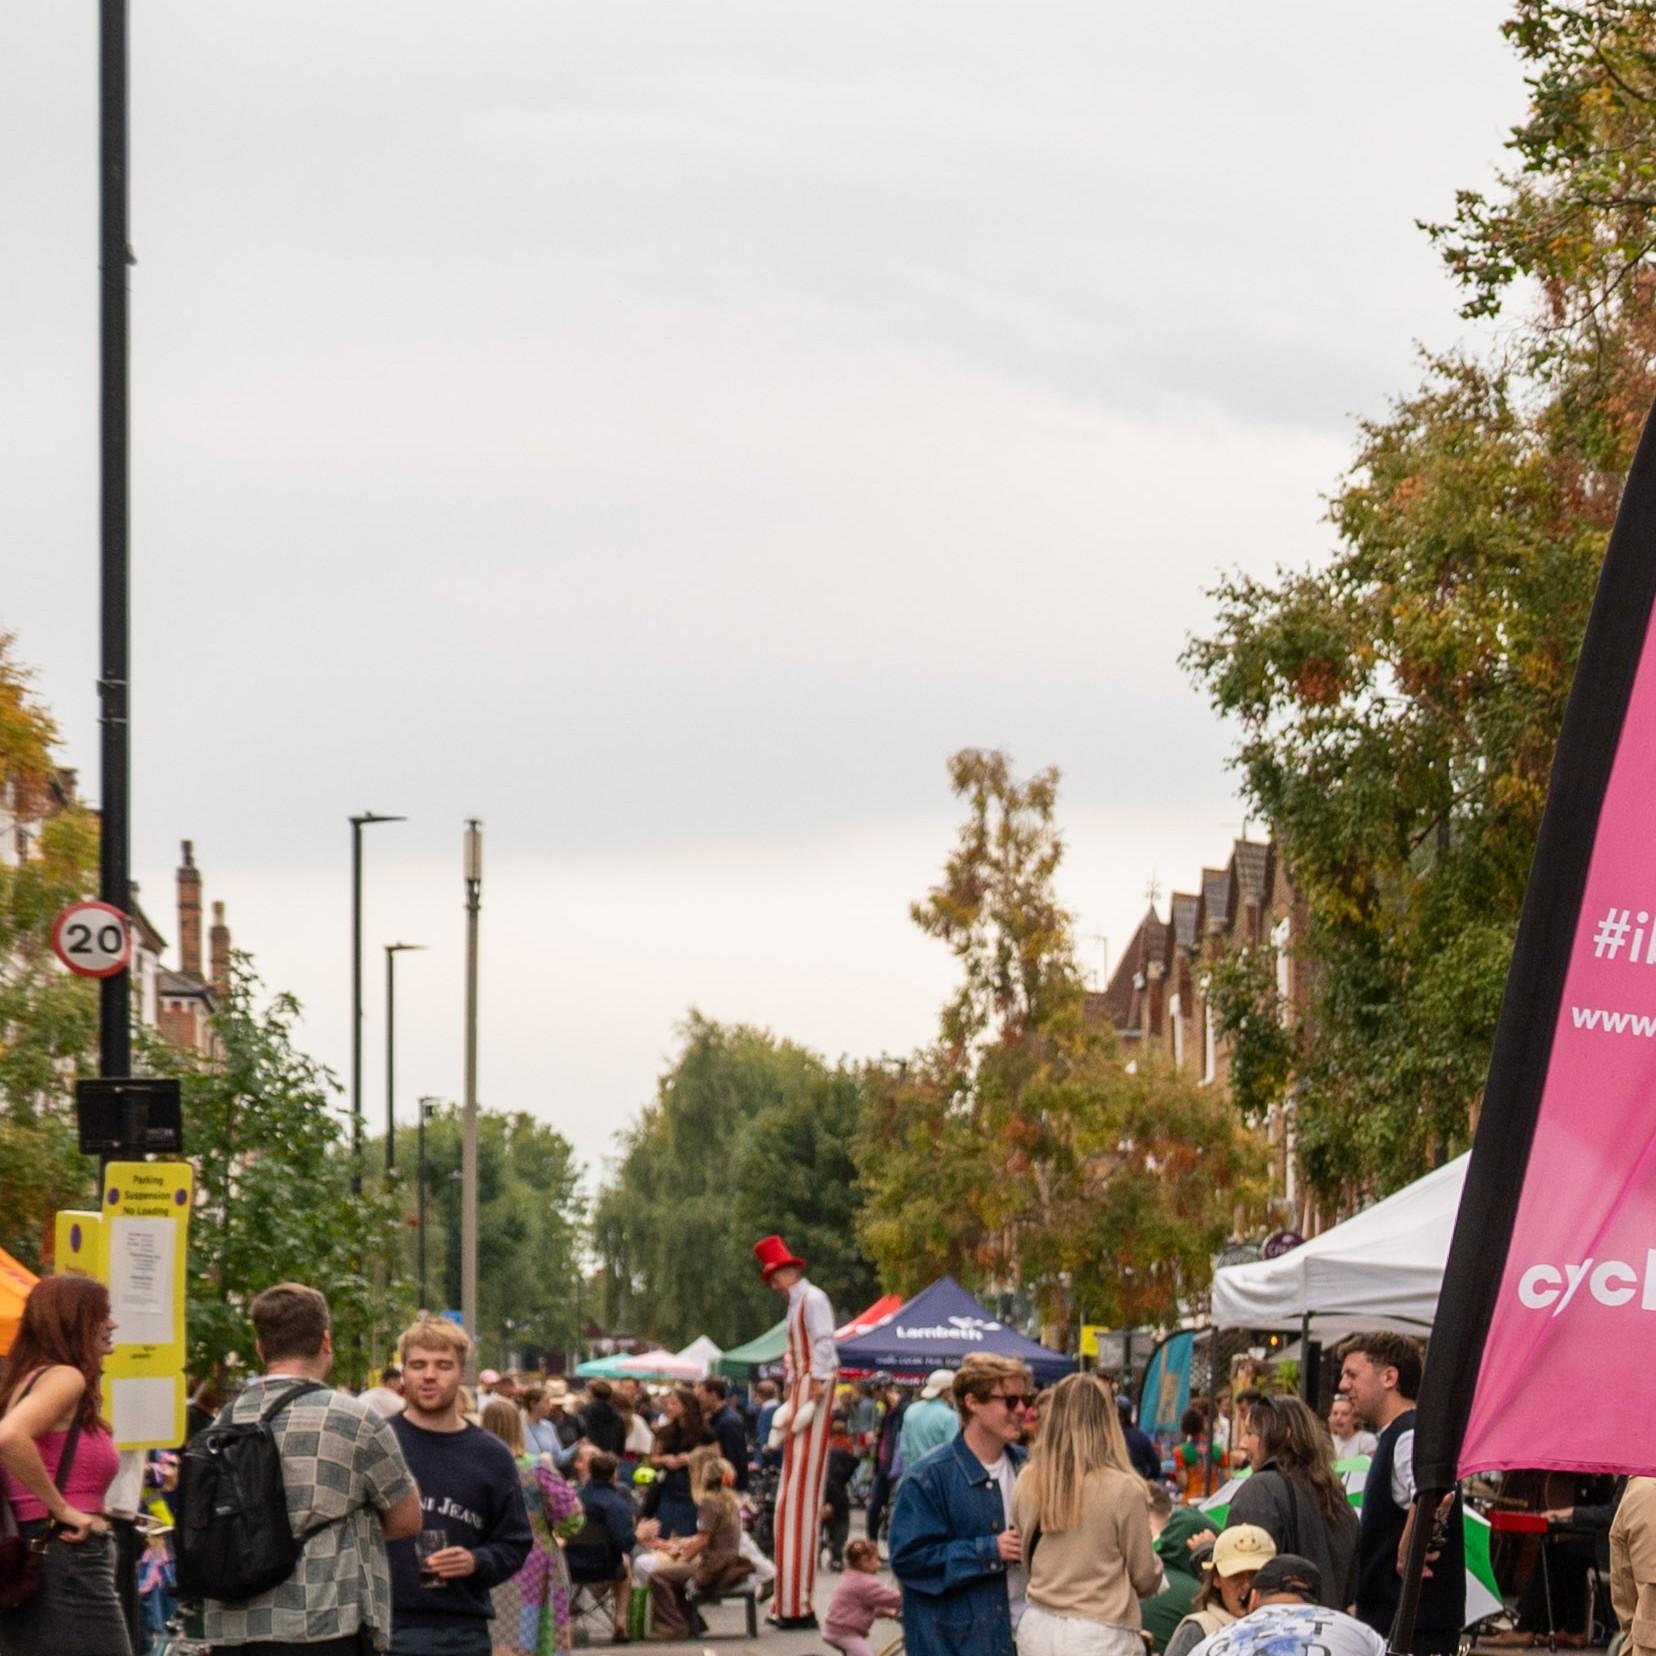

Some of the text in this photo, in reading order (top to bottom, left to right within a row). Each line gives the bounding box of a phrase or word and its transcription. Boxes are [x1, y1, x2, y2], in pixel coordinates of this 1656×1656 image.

[66, 924, 123, 954] 20
[132, 1174, 164, 1186] Parking
[123, 1190, 171, 1201] Suspension
[122, 1206, 169, 1217] No Loading
